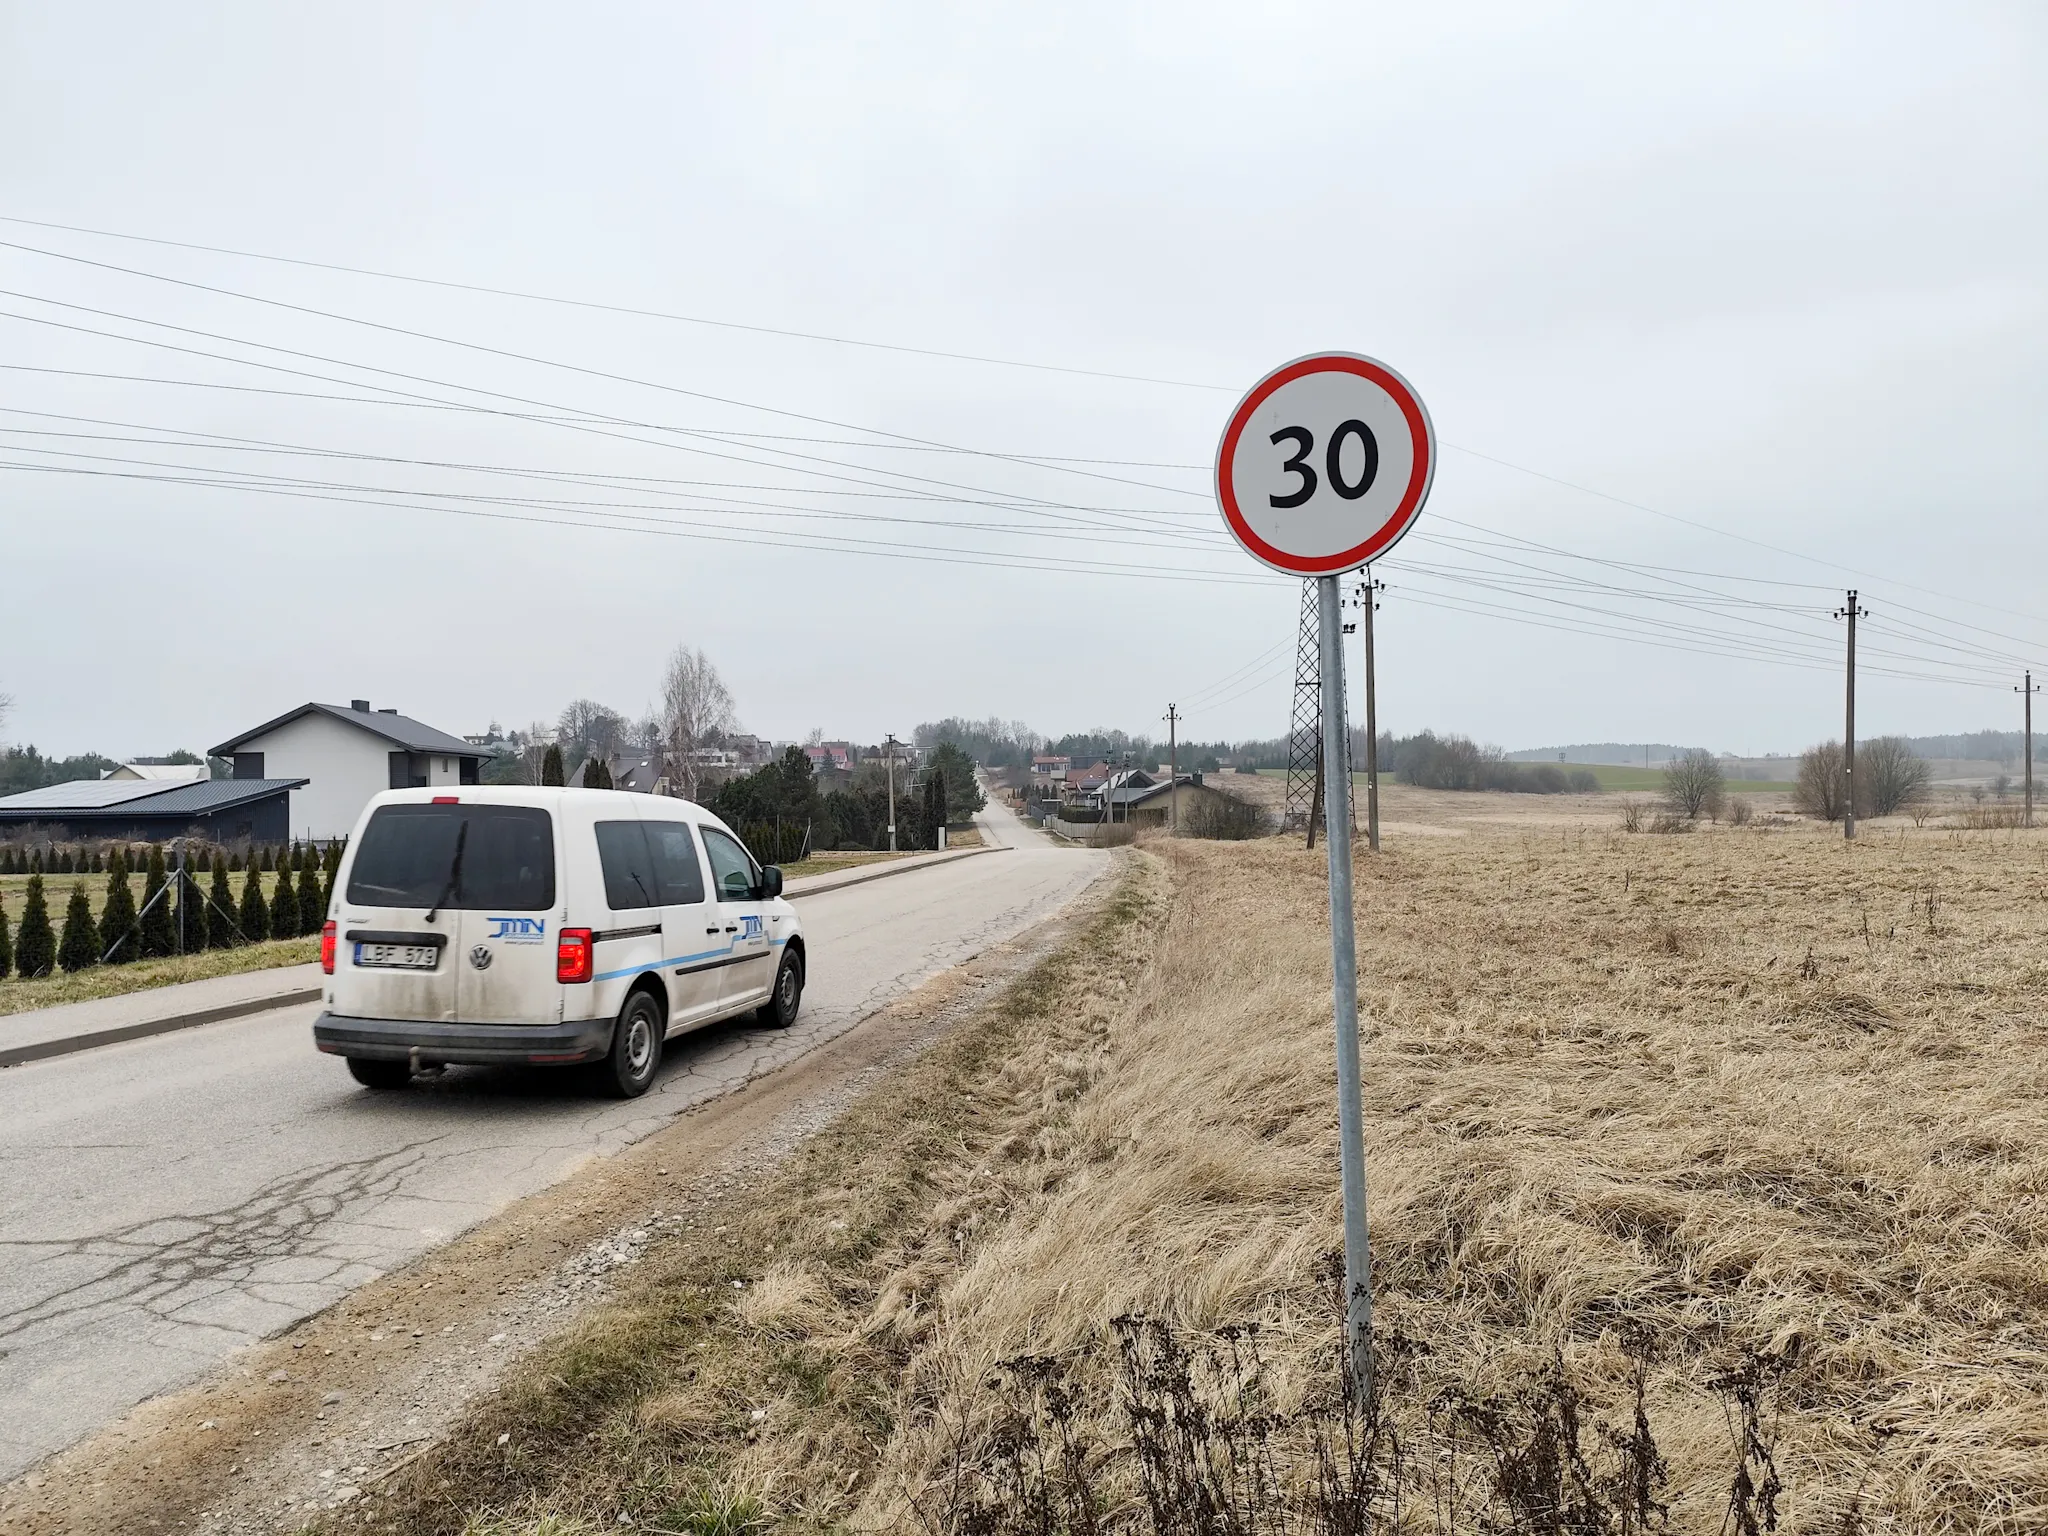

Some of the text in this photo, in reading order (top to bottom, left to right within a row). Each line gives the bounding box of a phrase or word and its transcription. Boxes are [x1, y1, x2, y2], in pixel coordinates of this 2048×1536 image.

[1269, 419, 1379, 509] 30
[363, 944, 435, 964] LBF 579
